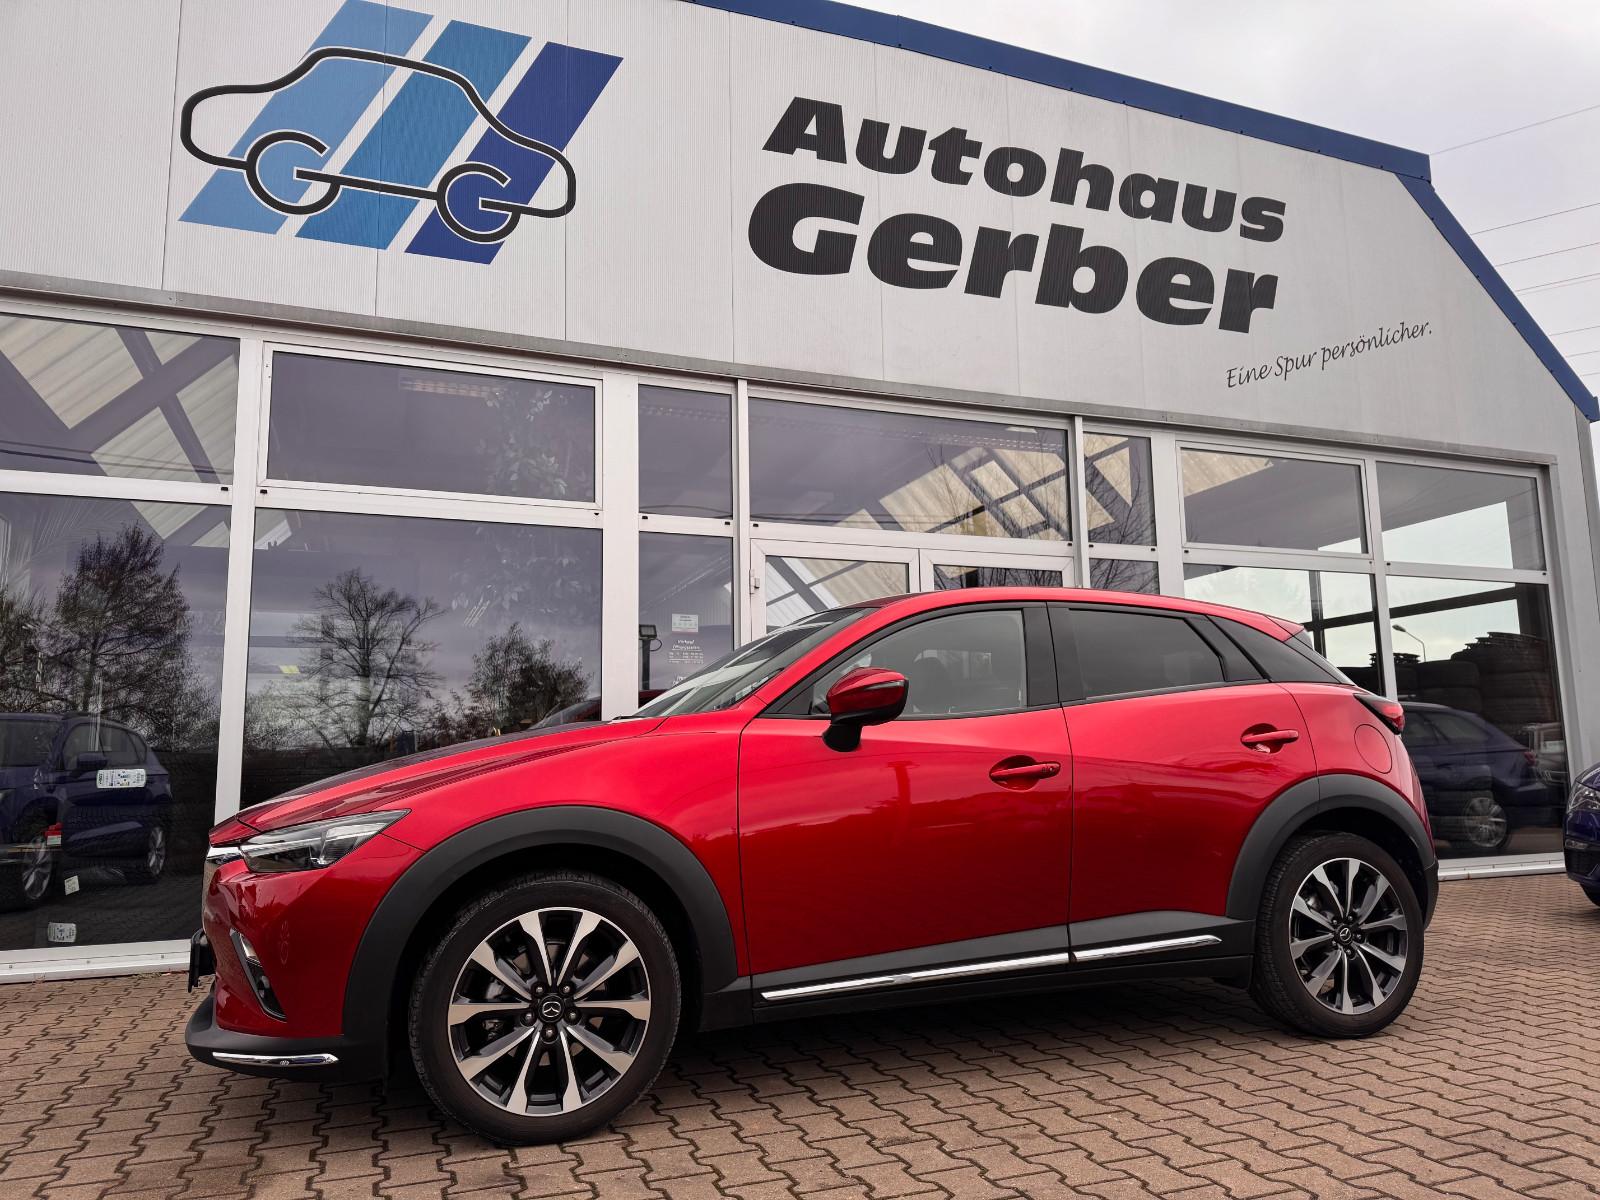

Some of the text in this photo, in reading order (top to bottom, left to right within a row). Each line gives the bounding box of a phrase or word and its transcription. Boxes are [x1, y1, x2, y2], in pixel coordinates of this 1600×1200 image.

[762, 96, 1286, 243] Autohaus
[748, 182, 1279, 334] Gerber
[1226, 321, 1433, 389] Eine Spur persönlicher.
